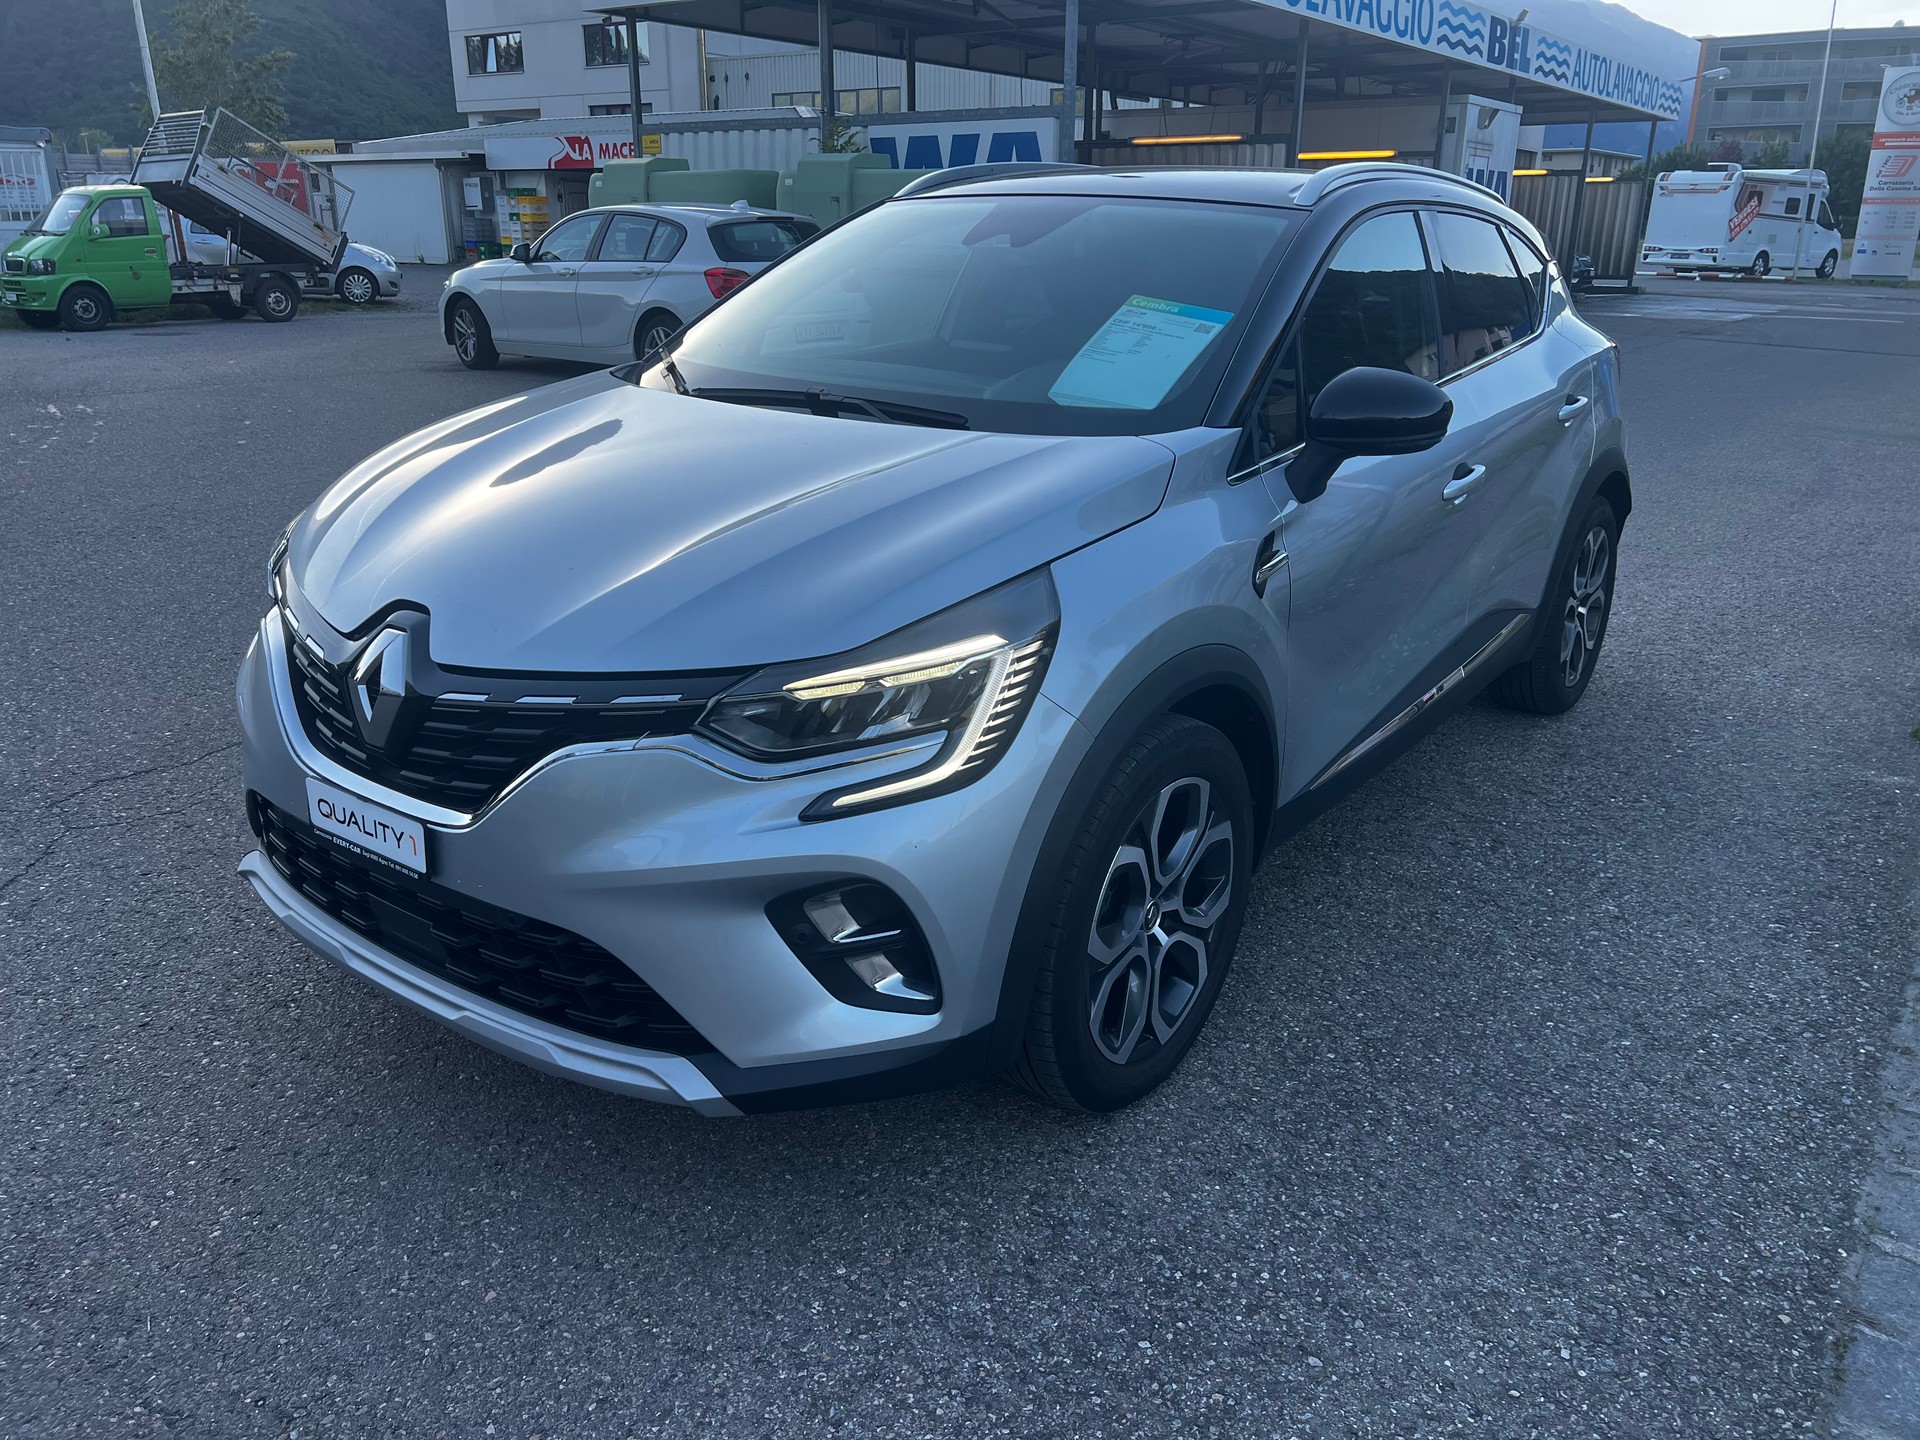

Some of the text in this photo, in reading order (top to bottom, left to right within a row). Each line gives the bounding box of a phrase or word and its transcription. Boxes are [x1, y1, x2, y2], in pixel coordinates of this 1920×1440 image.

[1487, 15, 1531, 74] BEL
[1131, 298, 1180, 313] Cembra
[1112, 318, 1131, 327] CHF
